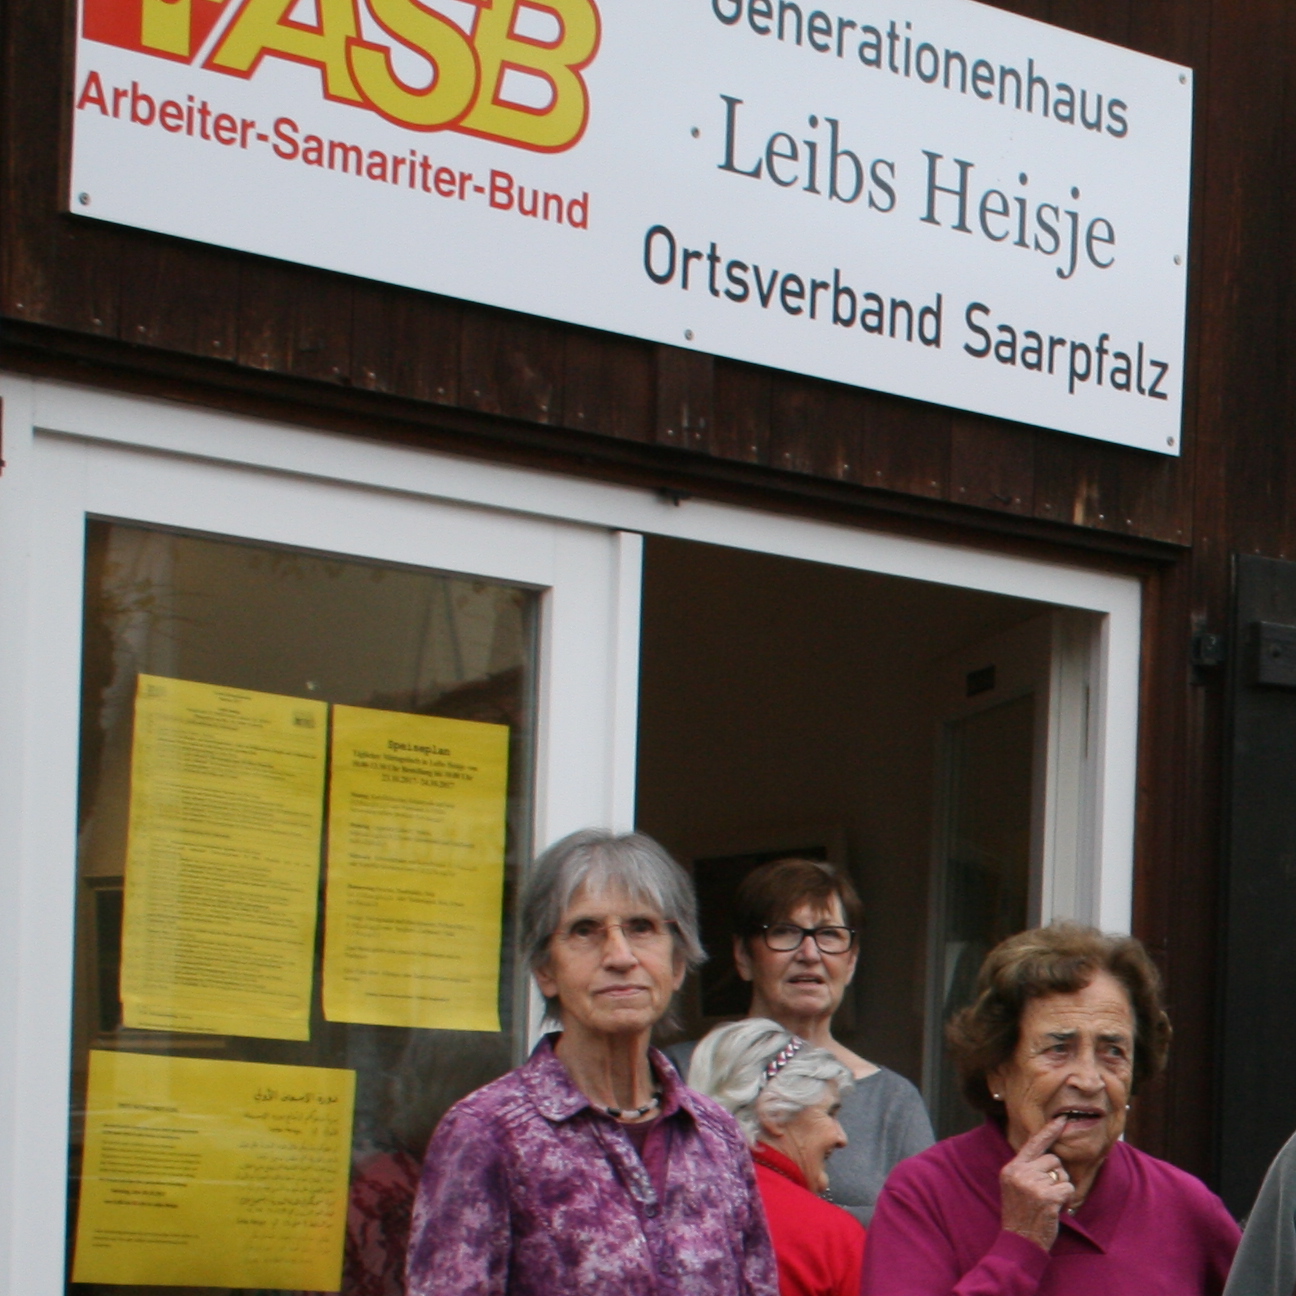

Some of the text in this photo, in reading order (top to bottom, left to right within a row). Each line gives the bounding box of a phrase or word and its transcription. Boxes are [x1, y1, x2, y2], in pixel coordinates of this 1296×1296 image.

[76, 71, 589, 230] Arbeiter-Samariter-Bund
[717, 94, 1116, 280] Leibs Heisje
[643, 224, 1170, 401] Ortsverband Saarpfalz
[388, 739, 451, 756] Speiseplan
